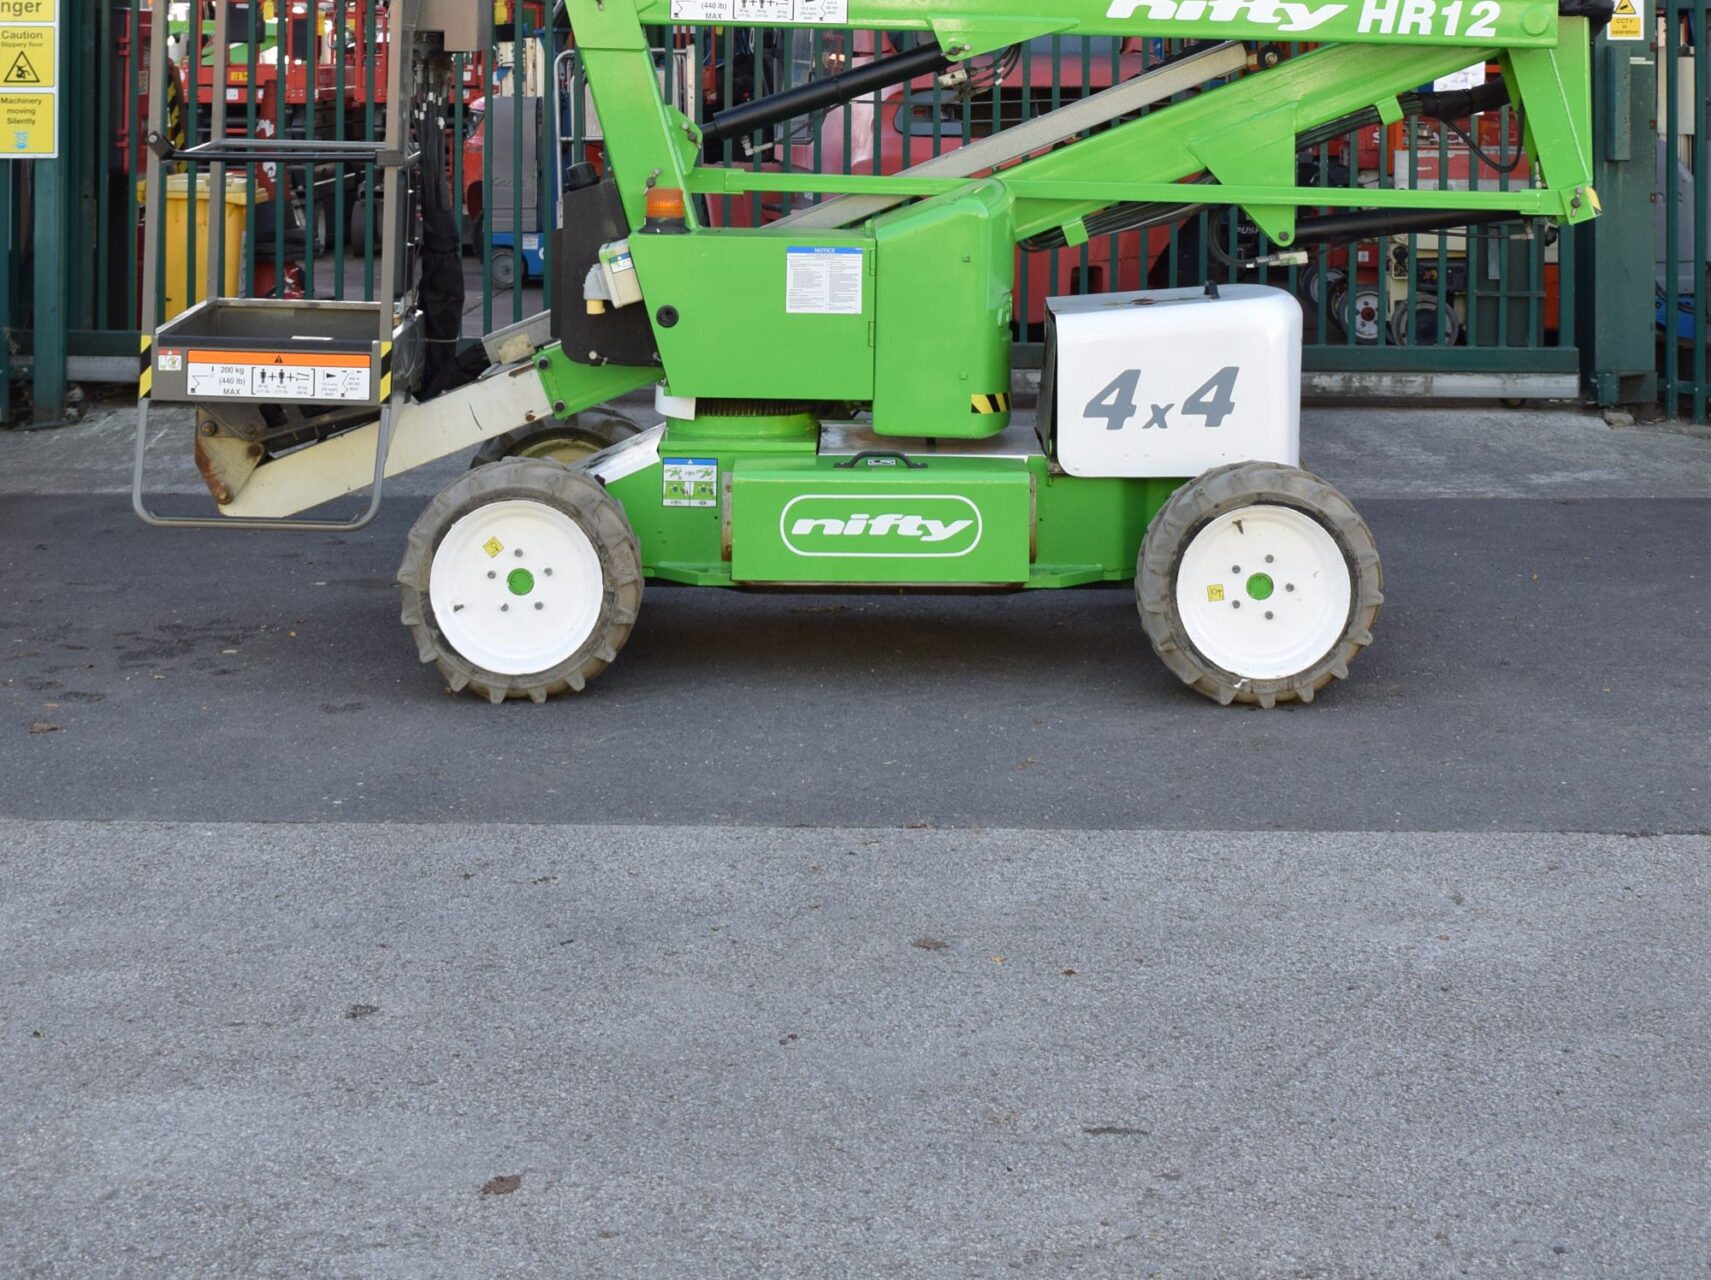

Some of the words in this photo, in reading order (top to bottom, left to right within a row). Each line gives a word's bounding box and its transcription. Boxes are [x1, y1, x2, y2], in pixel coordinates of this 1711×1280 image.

[705, 12, 722, 20] MAX
[1, 30, 43, 40] Caution
[0, 97, 42, 105] Machinery
[7, 108, 37, 116] moving
[6, 117, 36, 126] Silently
[235, 367, 245, 376] kg
[791, 513, 973, 542] nifty
